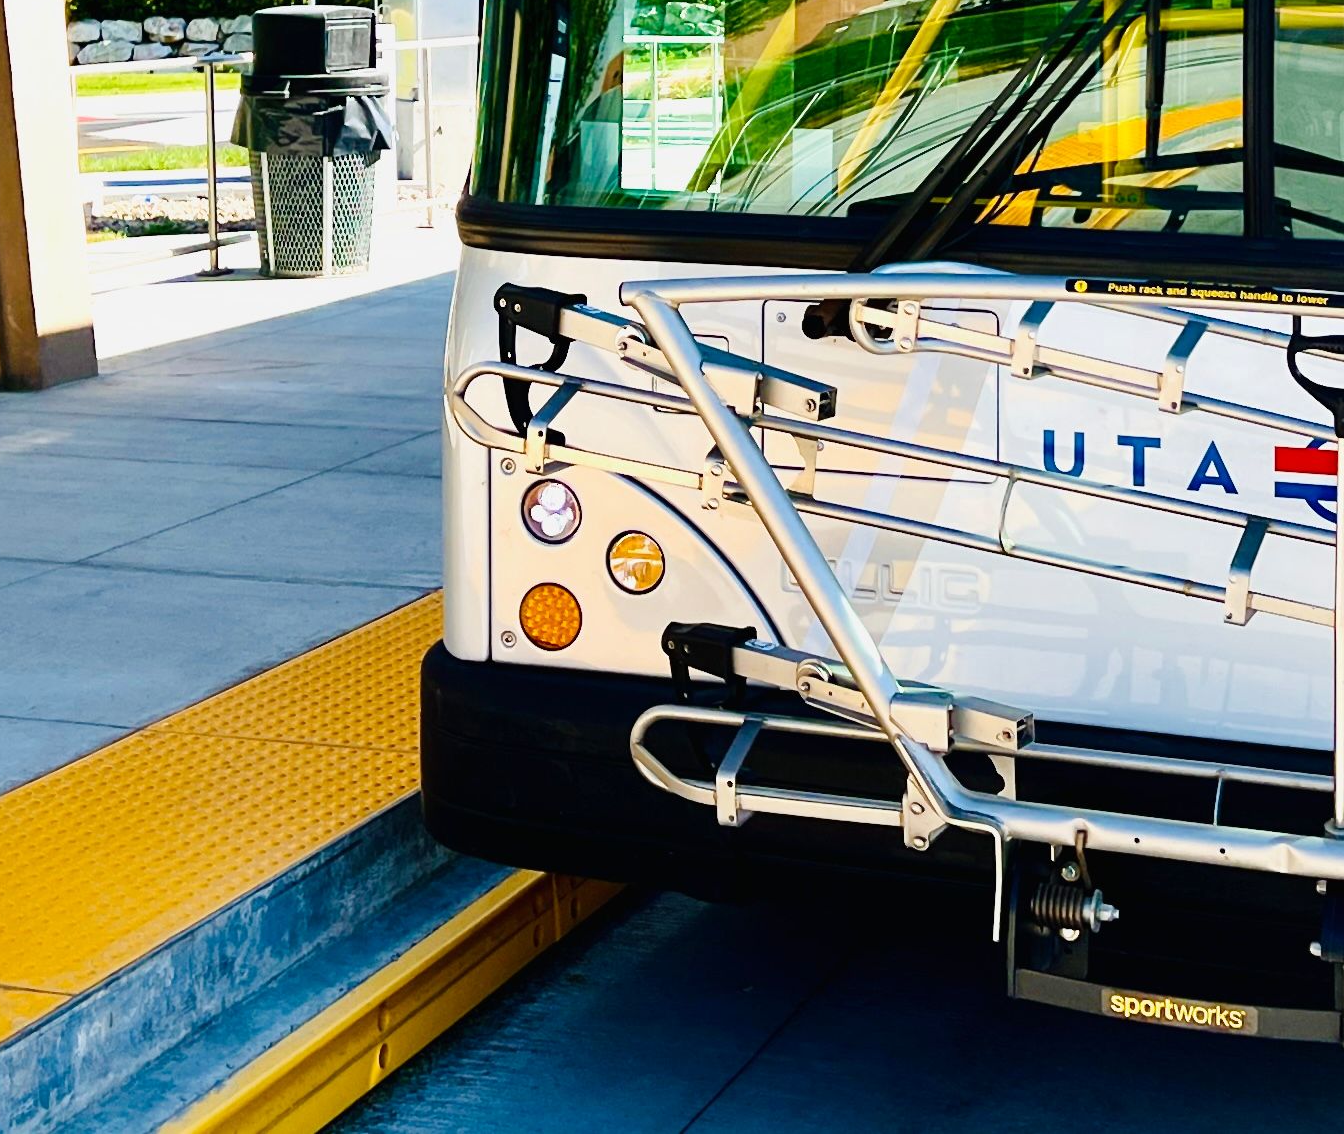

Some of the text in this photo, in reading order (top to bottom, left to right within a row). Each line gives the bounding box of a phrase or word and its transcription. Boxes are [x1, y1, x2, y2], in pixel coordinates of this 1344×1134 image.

[1107, 282, 1329, 306] Push rack and squeeze handle to lower
[1042, 428, 1239, 495] UTA
[1109, 993, 1246, 1029] sportworks
